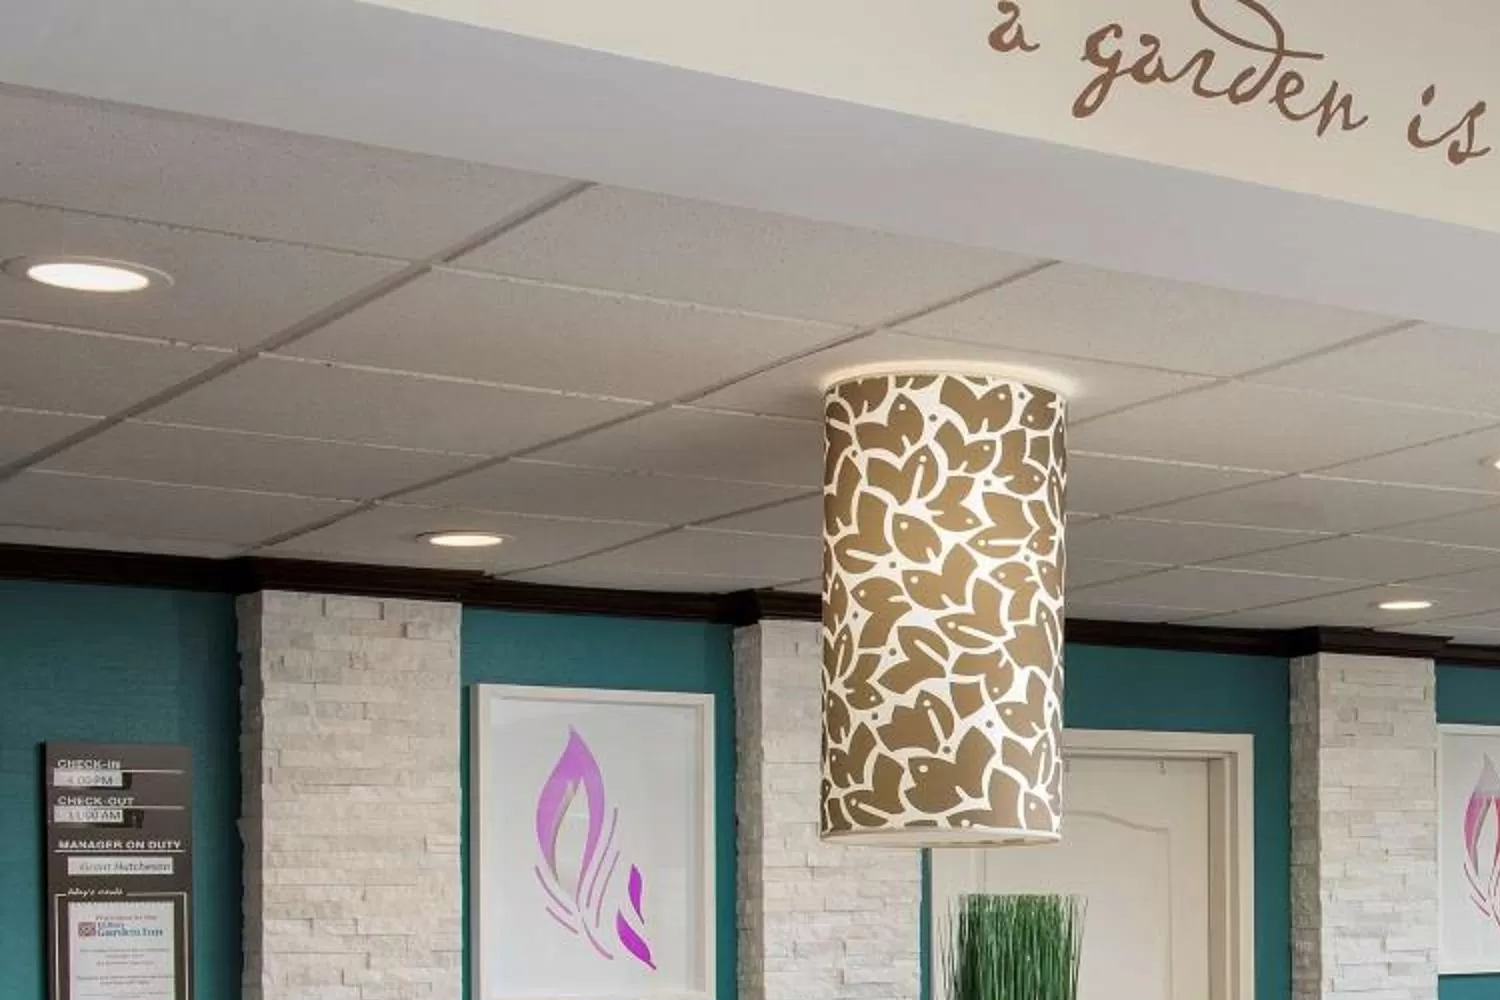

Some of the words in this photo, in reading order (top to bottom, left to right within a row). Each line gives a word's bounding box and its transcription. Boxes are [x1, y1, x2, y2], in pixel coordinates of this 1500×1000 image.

[987, 0, 1041, 53] a
[1072, 0, 1369, 138] garden
[1407, 83, 1492, 166] is
[58, 840, 123, 849] MANAGER
[125, 840, 145, 849] ON
[147, 840, 181, 849] DUTY
